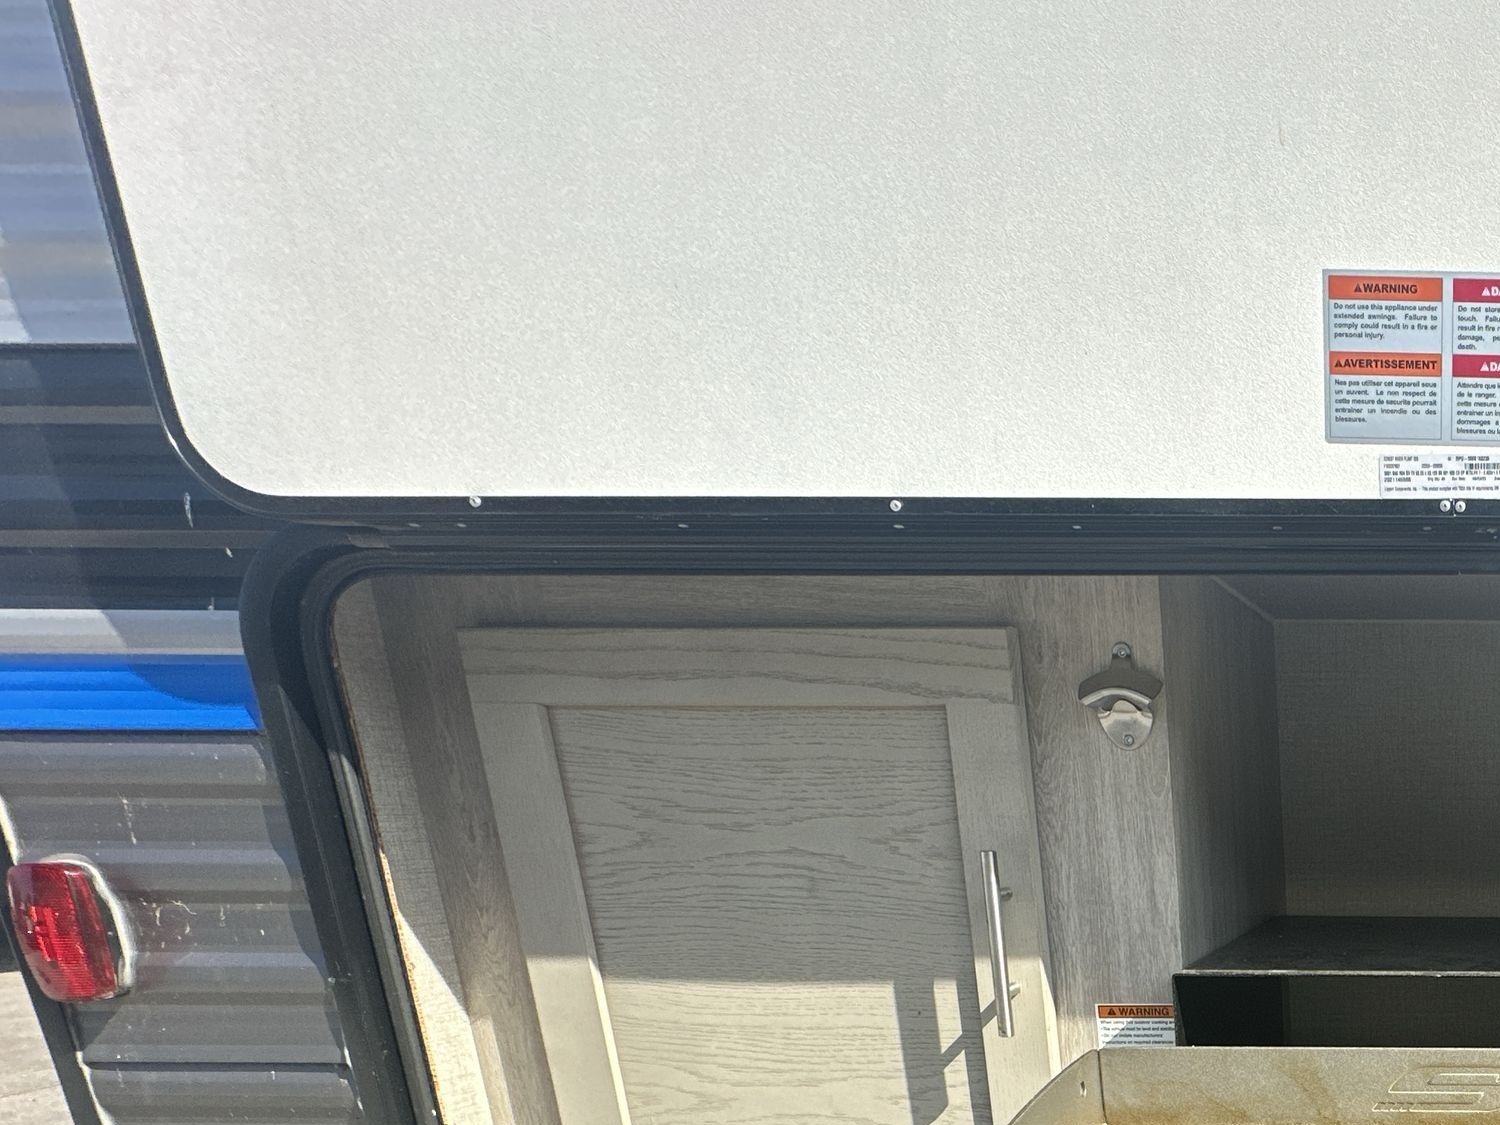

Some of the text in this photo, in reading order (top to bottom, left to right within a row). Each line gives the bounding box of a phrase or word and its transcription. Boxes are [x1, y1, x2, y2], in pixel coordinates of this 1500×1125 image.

[1363, 283, 1418, 294] WARNING
[1385, 304, 1417, 312] appliance
[1334, 332, 1385, 340] personal injury.
[1343, 359, 1437, 370] AVERTISSEMENT
[1395, 380, 1420, 388] appareil
[1118, 1008, 1170, 1016] WARNING
